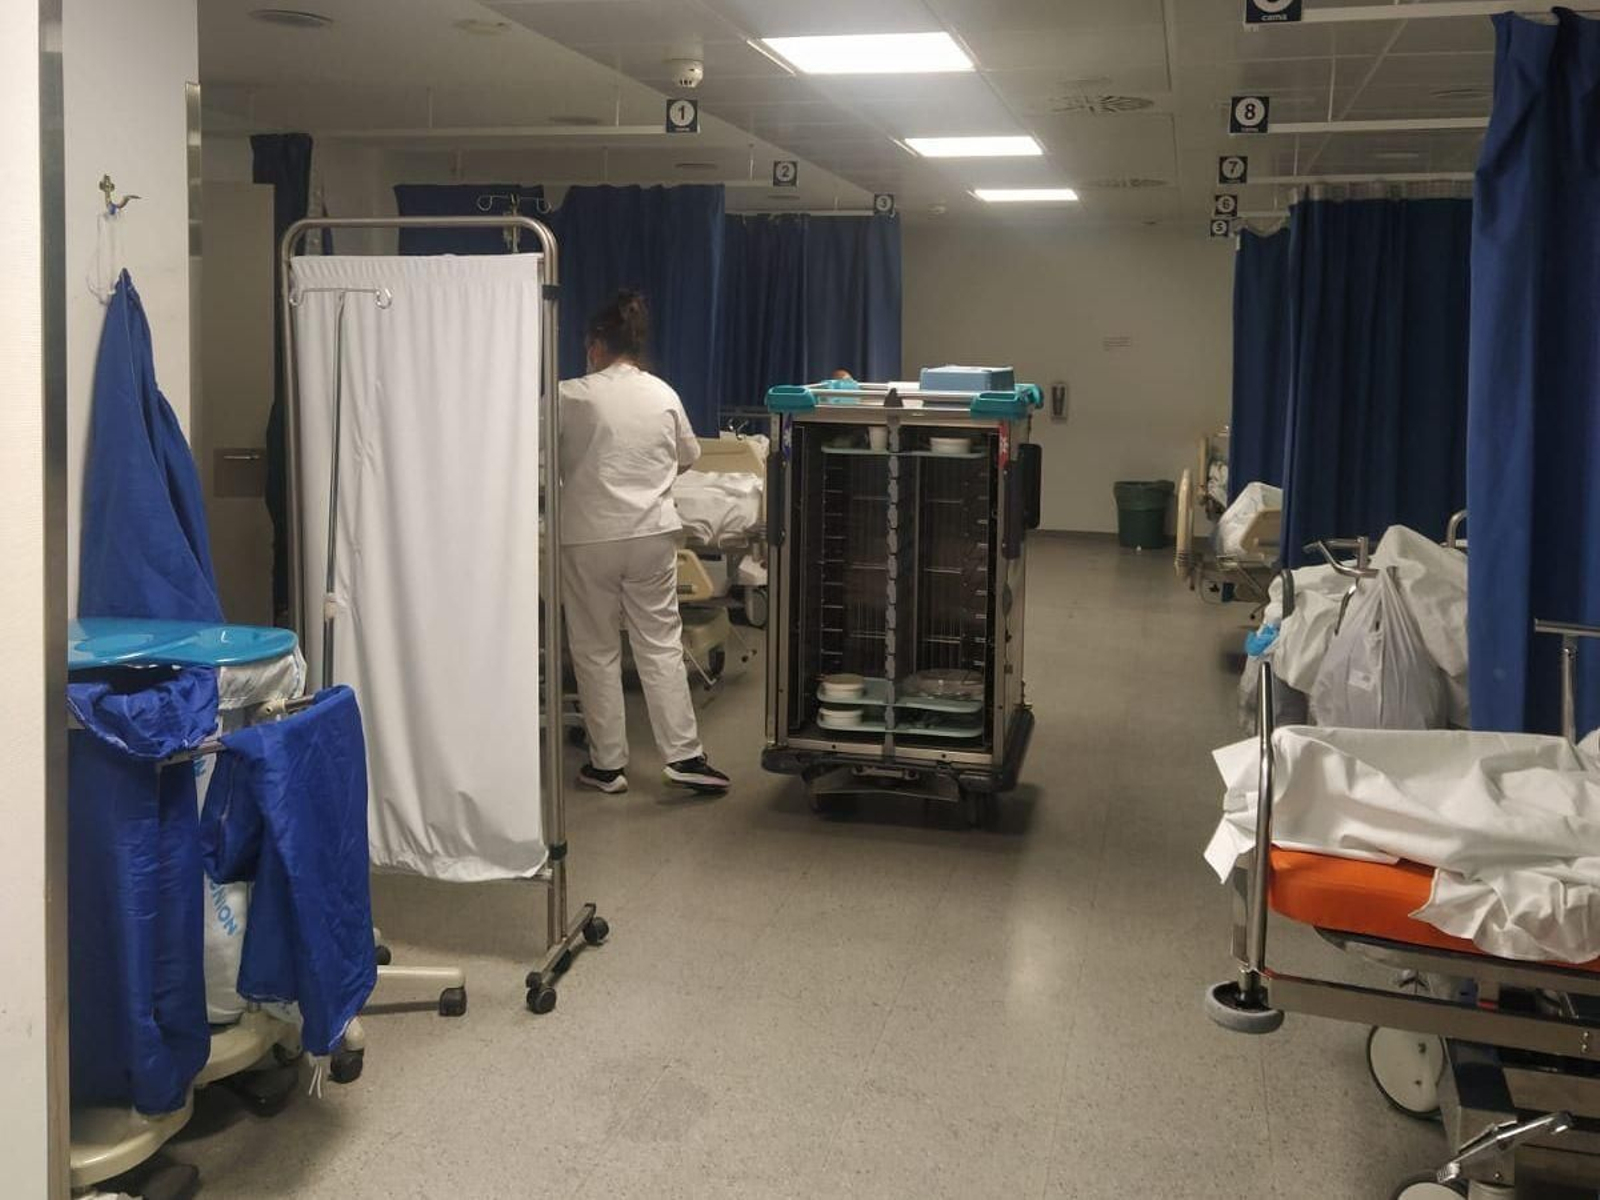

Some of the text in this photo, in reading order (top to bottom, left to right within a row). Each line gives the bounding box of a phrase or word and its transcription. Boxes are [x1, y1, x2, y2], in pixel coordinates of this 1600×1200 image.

[678, 105, 685, 120] 1
[1245, 103, 1256, 120] 8
[781, 165, 790, 178] 2
[1229, 161, 1238, 173] 7
[879, 197, 888, 208] 3
[1223, 198, 1230, 210] 6
[1216, 222, 1223, 232] 5
